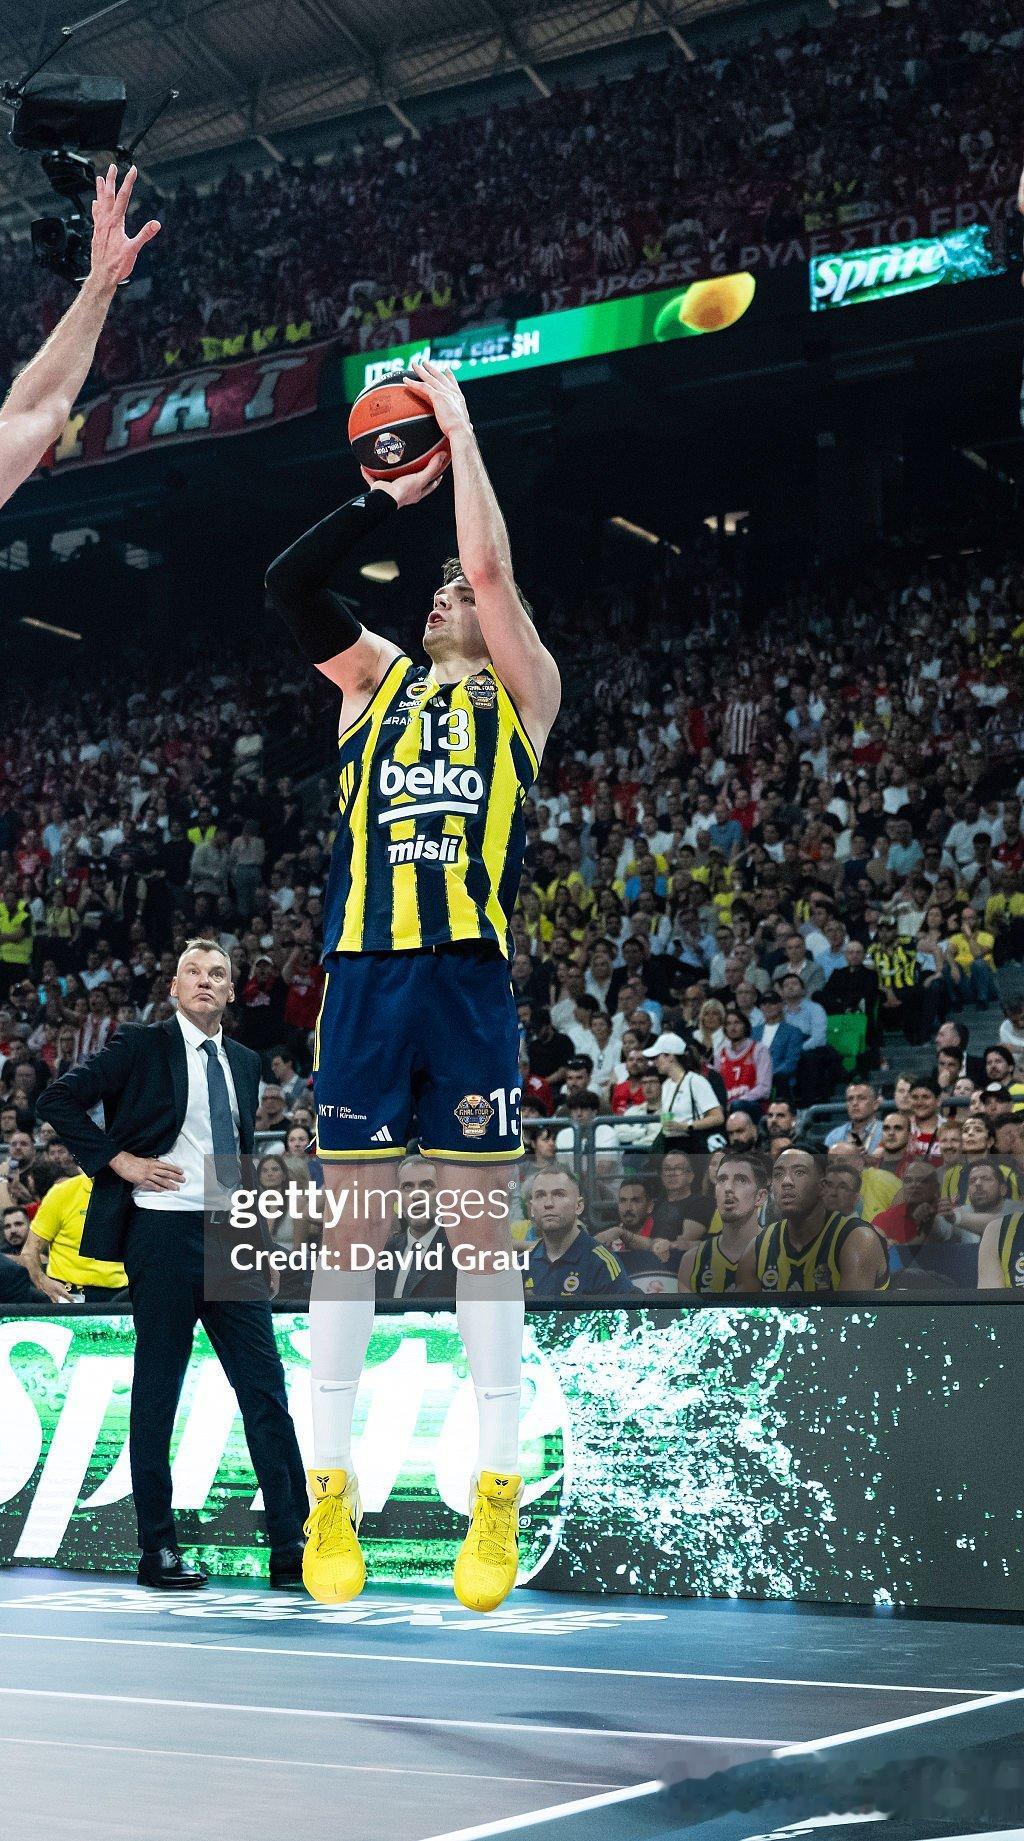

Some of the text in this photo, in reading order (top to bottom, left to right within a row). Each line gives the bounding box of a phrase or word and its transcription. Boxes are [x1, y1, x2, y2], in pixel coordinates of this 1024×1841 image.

[814, 242, 948, 303] Sprite
[419, 707, 470, 752] 13
[379, 759, 484, 801] beko
[387, 834, 459, 864] misli
[489, 1087, 522, 1137] 13
[166, 1605, 623, 1635] GAME
[483, 1608, 670, 1622] UP
